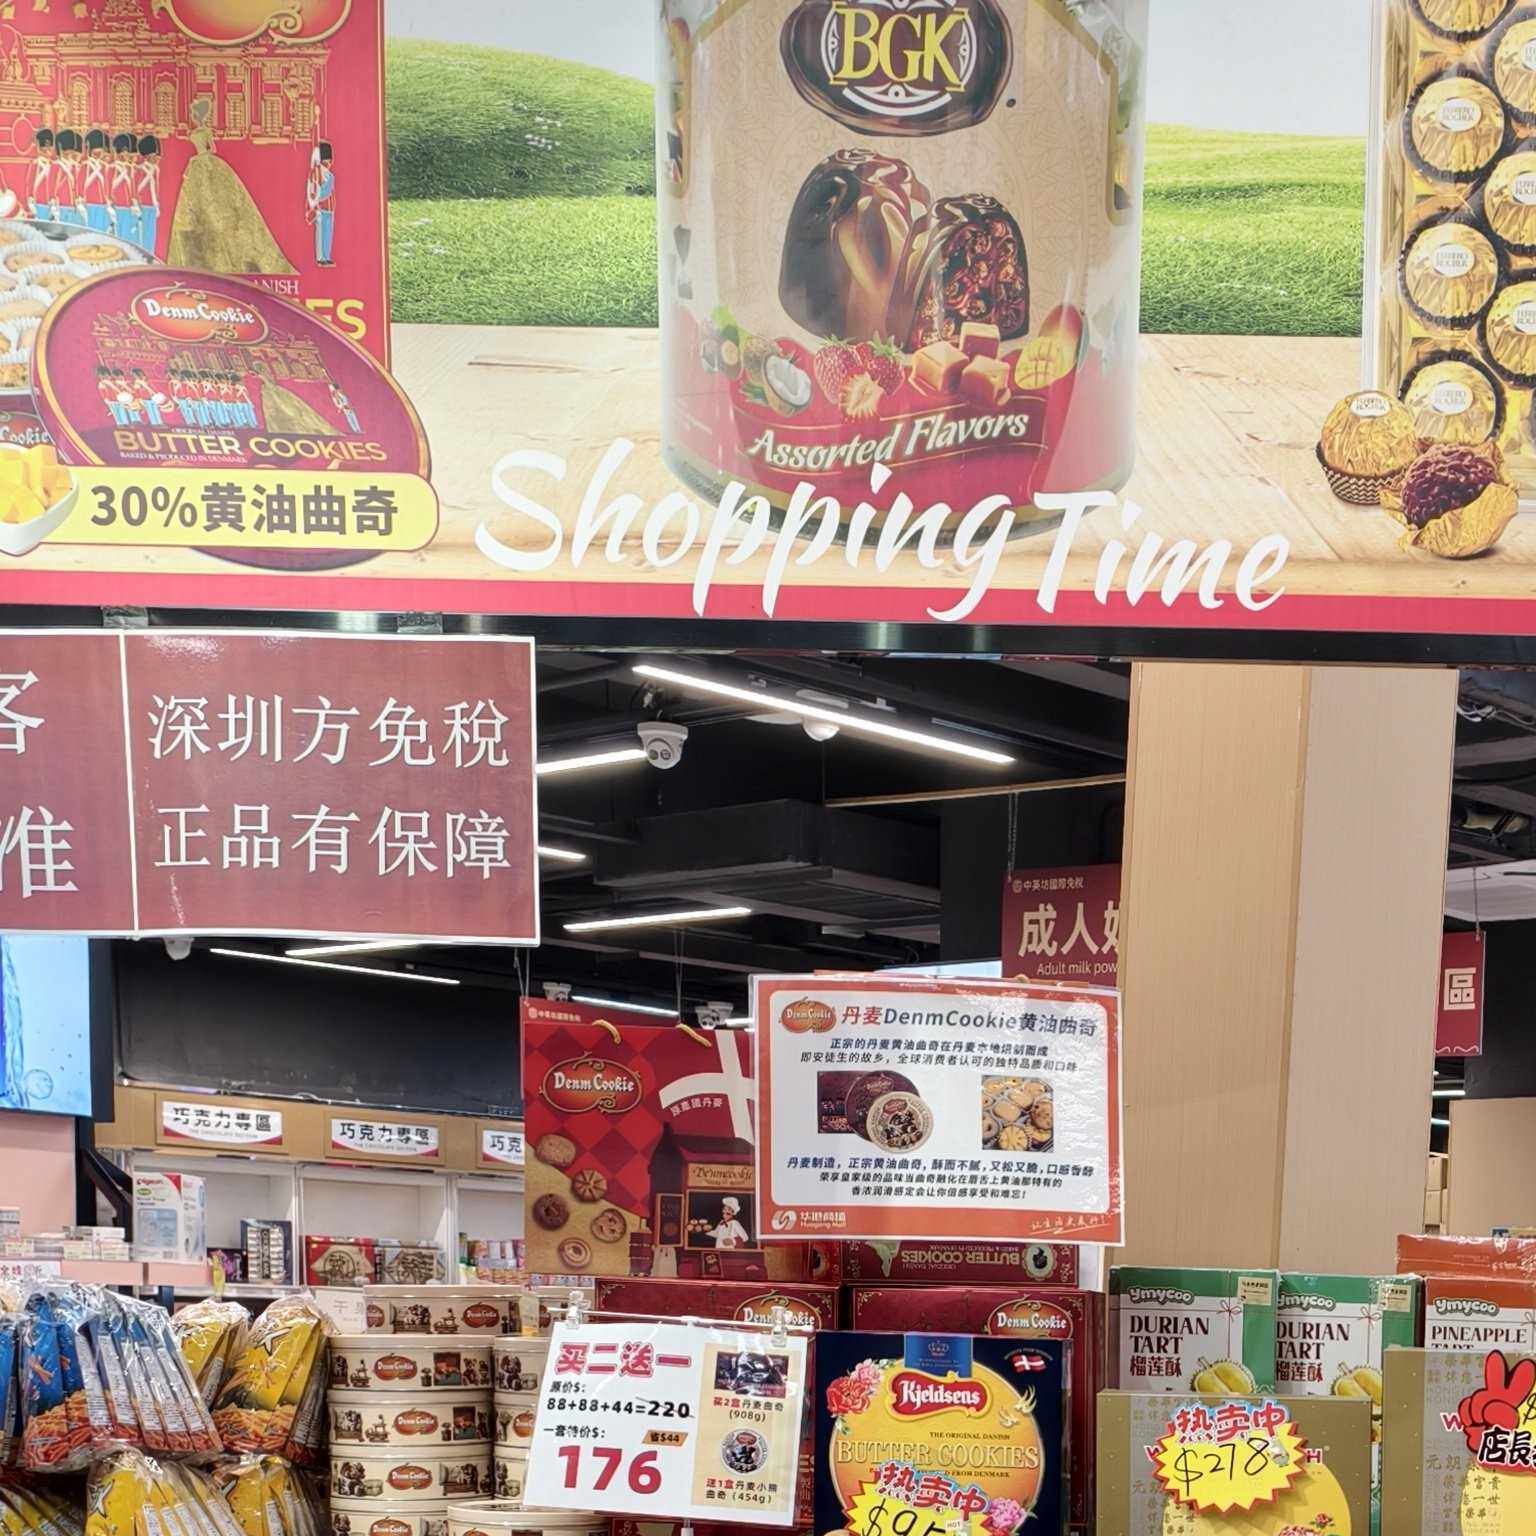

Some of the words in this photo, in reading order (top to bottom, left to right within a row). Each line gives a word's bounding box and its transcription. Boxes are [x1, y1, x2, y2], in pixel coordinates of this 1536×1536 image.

[842, 2, 962, 84] BGK
[114, 430, 244, 456] BUTTER
[249, 436, 389, 463] COOKIES
[748, 422, 898, 472] Assorted
[903, 408, 1027, 459] Flavors
[91, 482, 399, 536] 30%黄油曲奇
[474, 438, 1013, 622] Shopping
[1033, 490, 1292, 614] Time
[153, 803, 511, 880] 正品有保障
[1036, 961, 1065, 976] Adult
[1068, 960, 1091, 974] milk
[1442, 967, 1477, 1011] 區
[901, 1251, 963, 1264] COOKIES
[966, 1252, 1020, 1265] BUTTER
[1129, 1288, 1193, 1305] ymycoo
[1435, 1299, 1497, 1315] ymycoo
[1130, 1315, 1210, 1336] DURIAN
[1277, 1321, 1350, 1341] DURIAN
[1431, 1326, 1527, 1344] PINEAPPLE
[555, 1341, 693, 1378] 买二送一
[1130, 1335, 1183, 1355] TART
[1277, 1341, 1325, 1360] TART
[1130, 1356, 1183, 1377] 榴莲酥
[1277, 1361, 1323, 1382] 榴莲酥
[900, 1379, 981, 1411] Kjeldsens
[837, 1440, 931, 1466] BUTTER
[938, 1443, 1040, 1469] COOKIES
[1174, 1436, 1272, 1495] $278
[558, 1444, 662, 1495] 176
[878, 1462, 988, 1521] 热卖中
